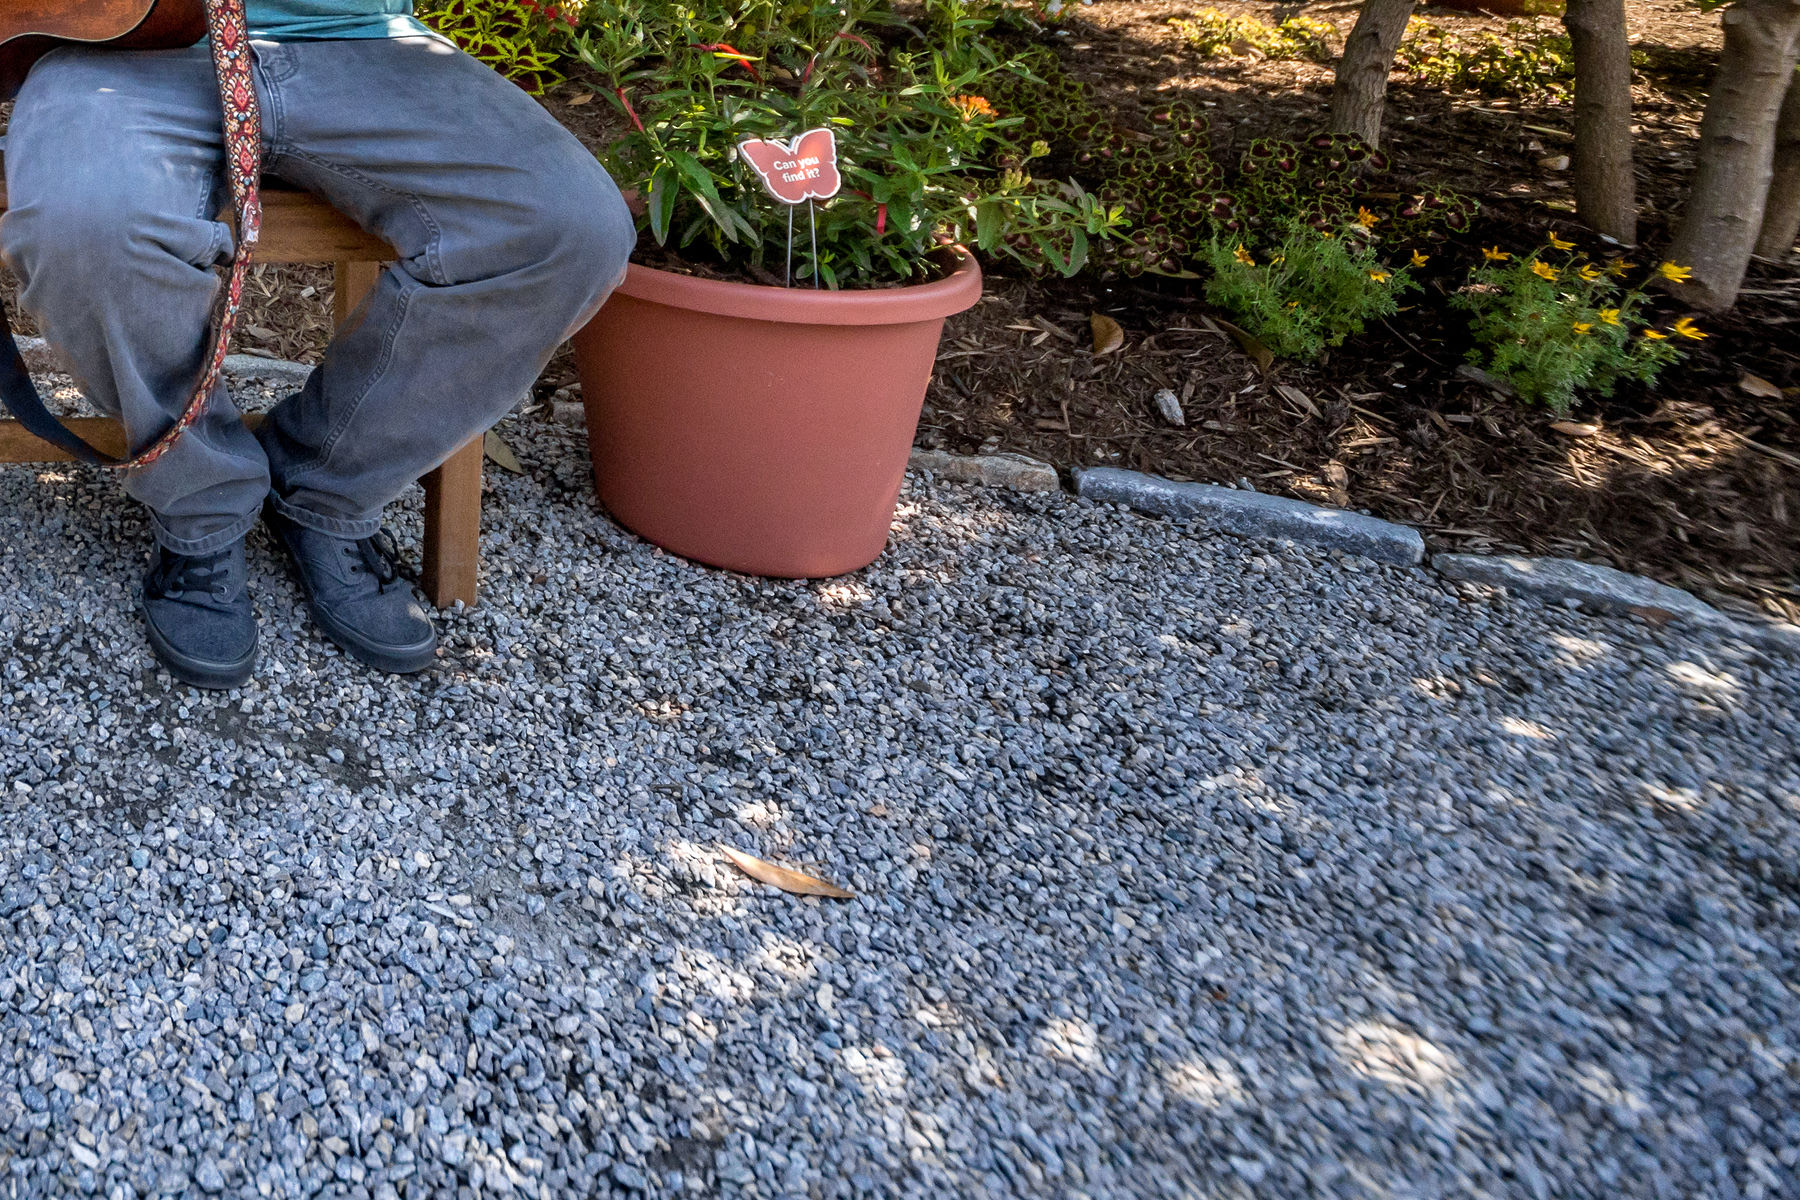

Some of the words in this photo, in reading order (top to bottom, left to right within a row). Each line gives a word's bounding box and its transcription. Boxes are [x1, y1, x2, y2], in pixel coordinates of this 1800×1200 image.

[773, 160, 797, 170] Can
[797, 156, 820, 169] you
[782, 171, 806, 182] find
[806, 167, 820, 179] it?
